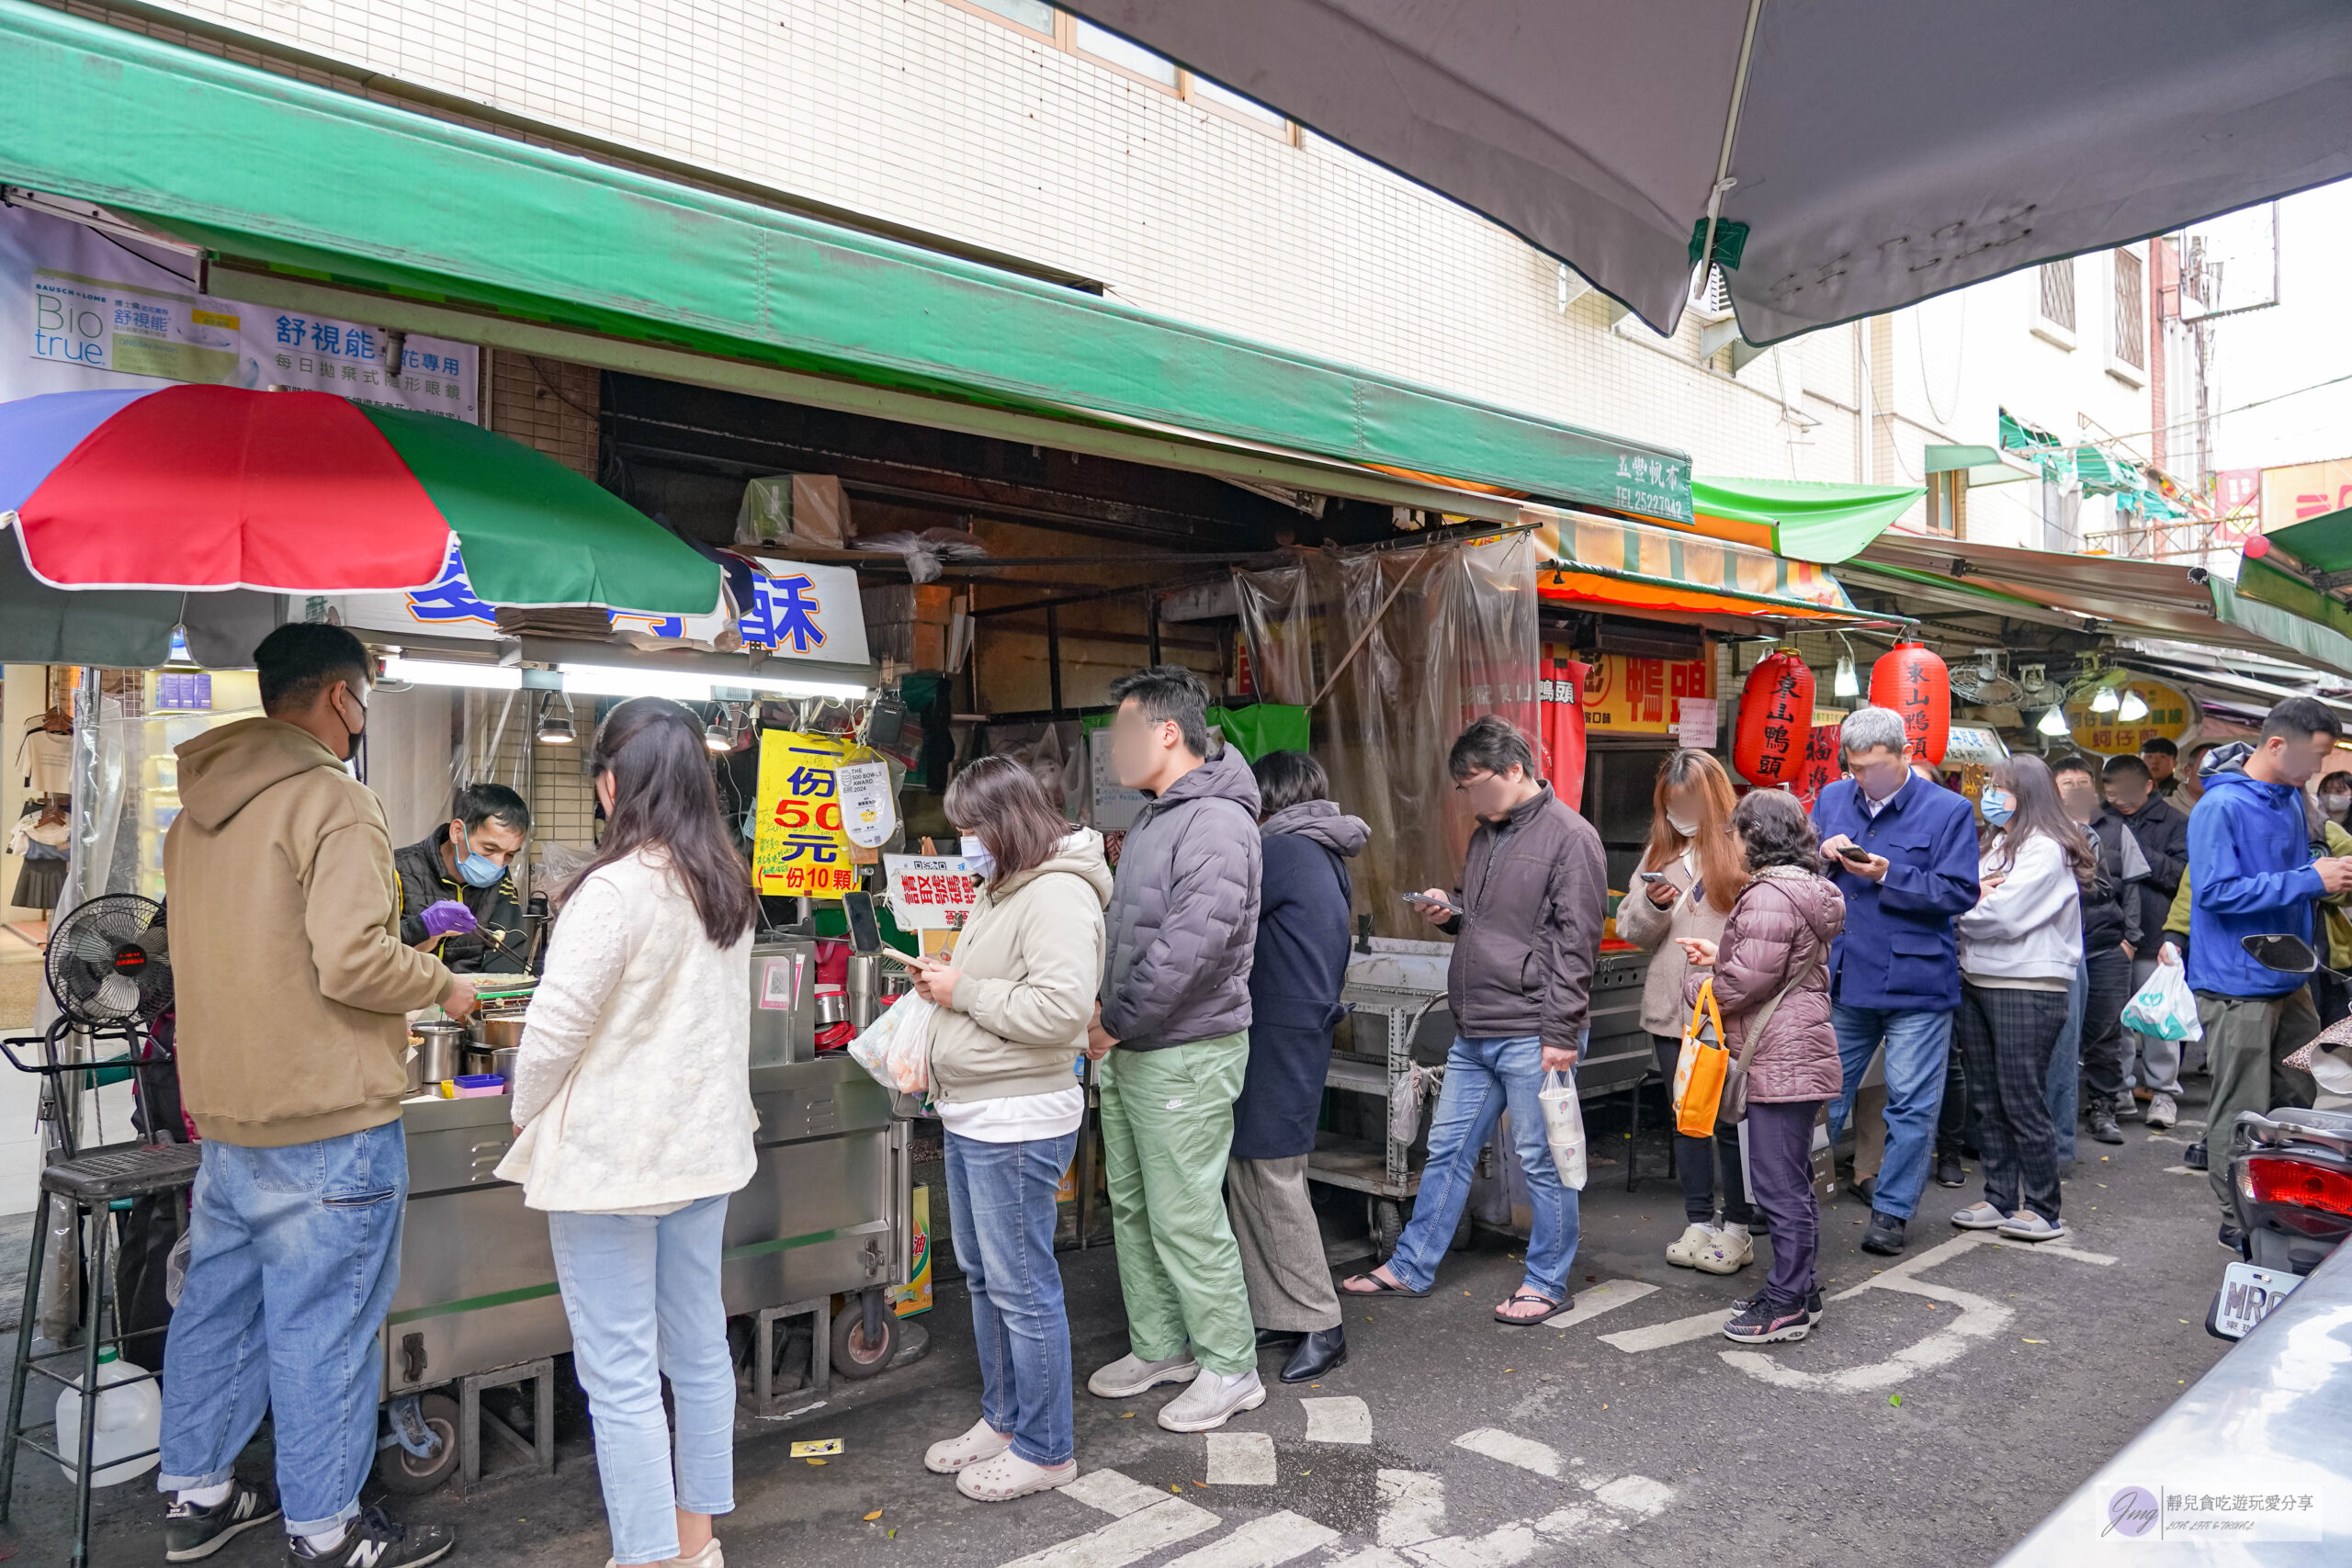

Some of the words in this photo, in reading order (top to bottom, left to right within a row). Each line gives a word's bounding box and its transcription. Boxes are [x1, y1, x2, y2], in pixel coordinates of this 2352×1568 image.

[114, 309, 168, 332] 舒視能
[35, 329, 103, 365] true
[276, 315, 377, 360] 舒視能
[382, 345, 459, 377] 花專用
[1616, 485, 1634, 509] TEL
[1635, 491, 1683, 519] 25227942
[1756, 671, 1802, 779] 東山鴨頭
